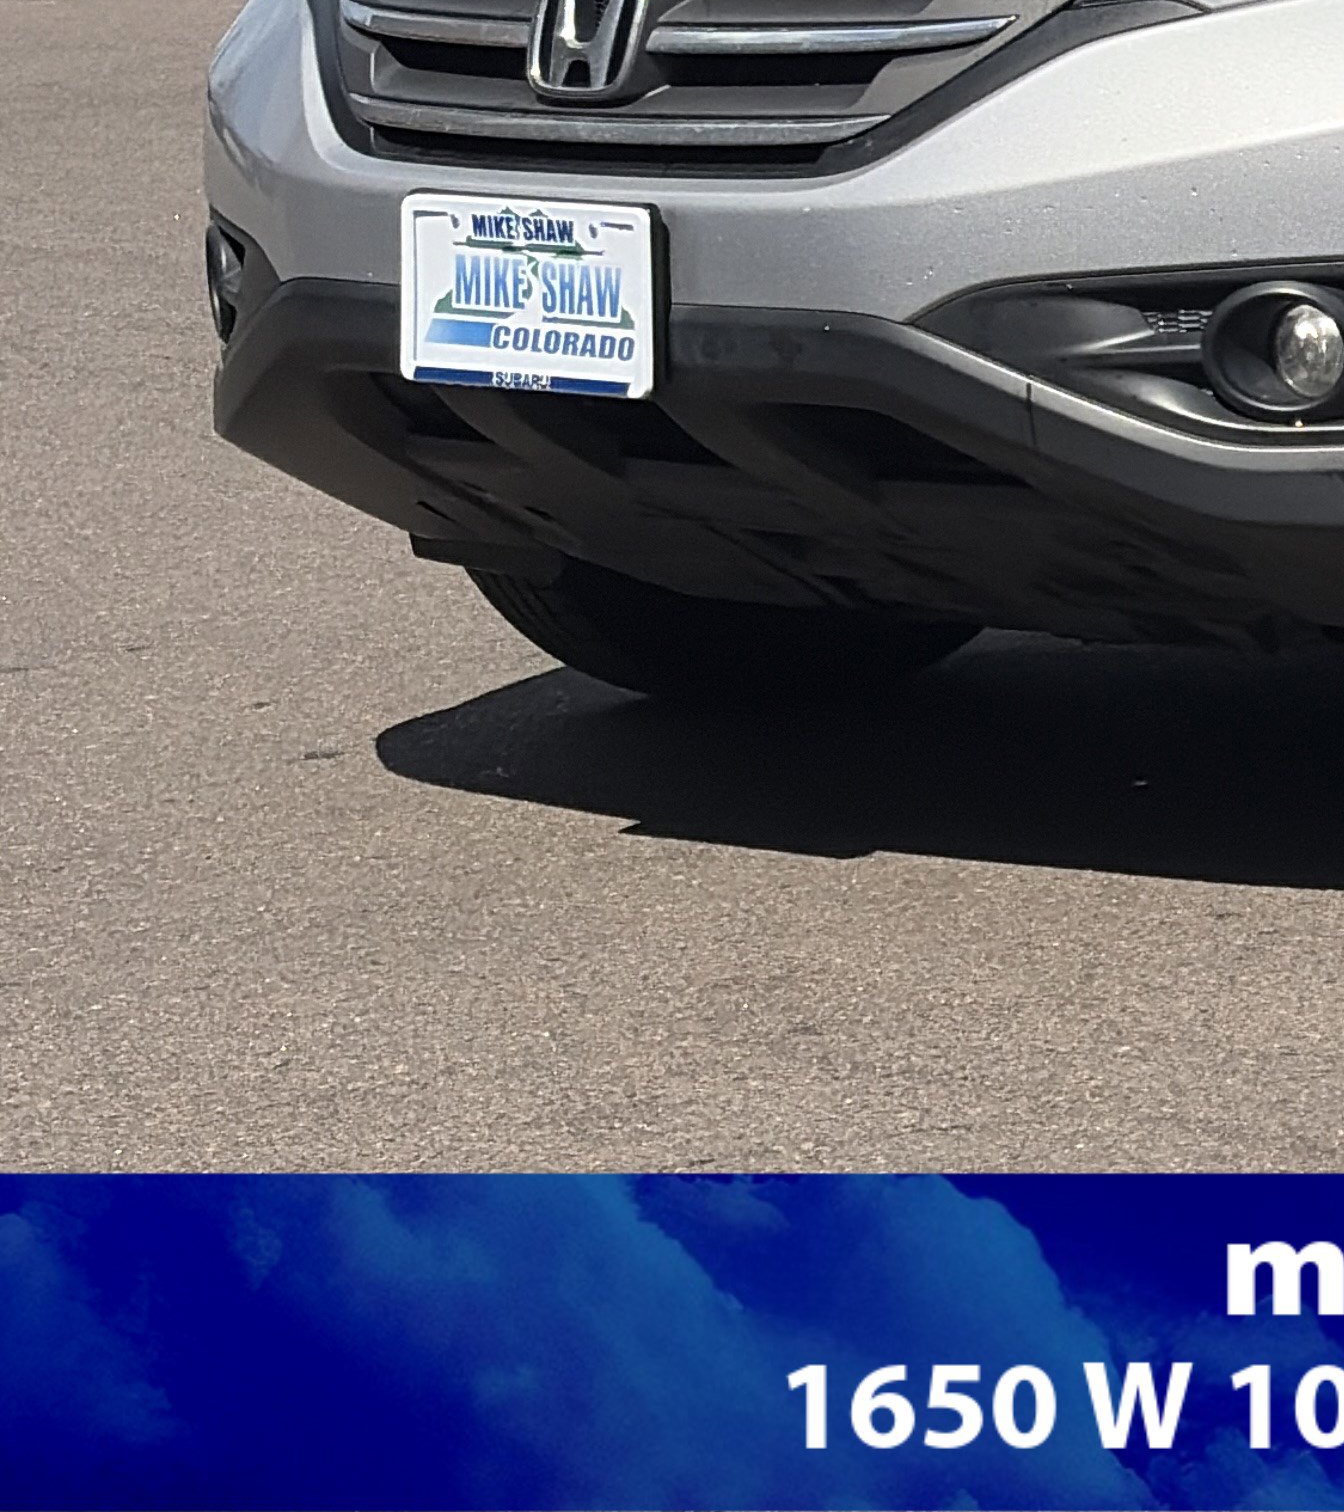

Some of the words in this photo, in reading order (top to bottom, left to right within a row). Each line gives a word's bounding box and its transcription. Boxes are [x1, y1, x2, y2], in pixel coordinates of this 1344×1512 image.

[471, 213, 515, 239] MIKE
[522, 215, 575, 244] SHAW
[454, 253, 526, 310] MIKE
[541, 260, 622, 318] SHAW
[492, 325, 636, 362] COLORADO
